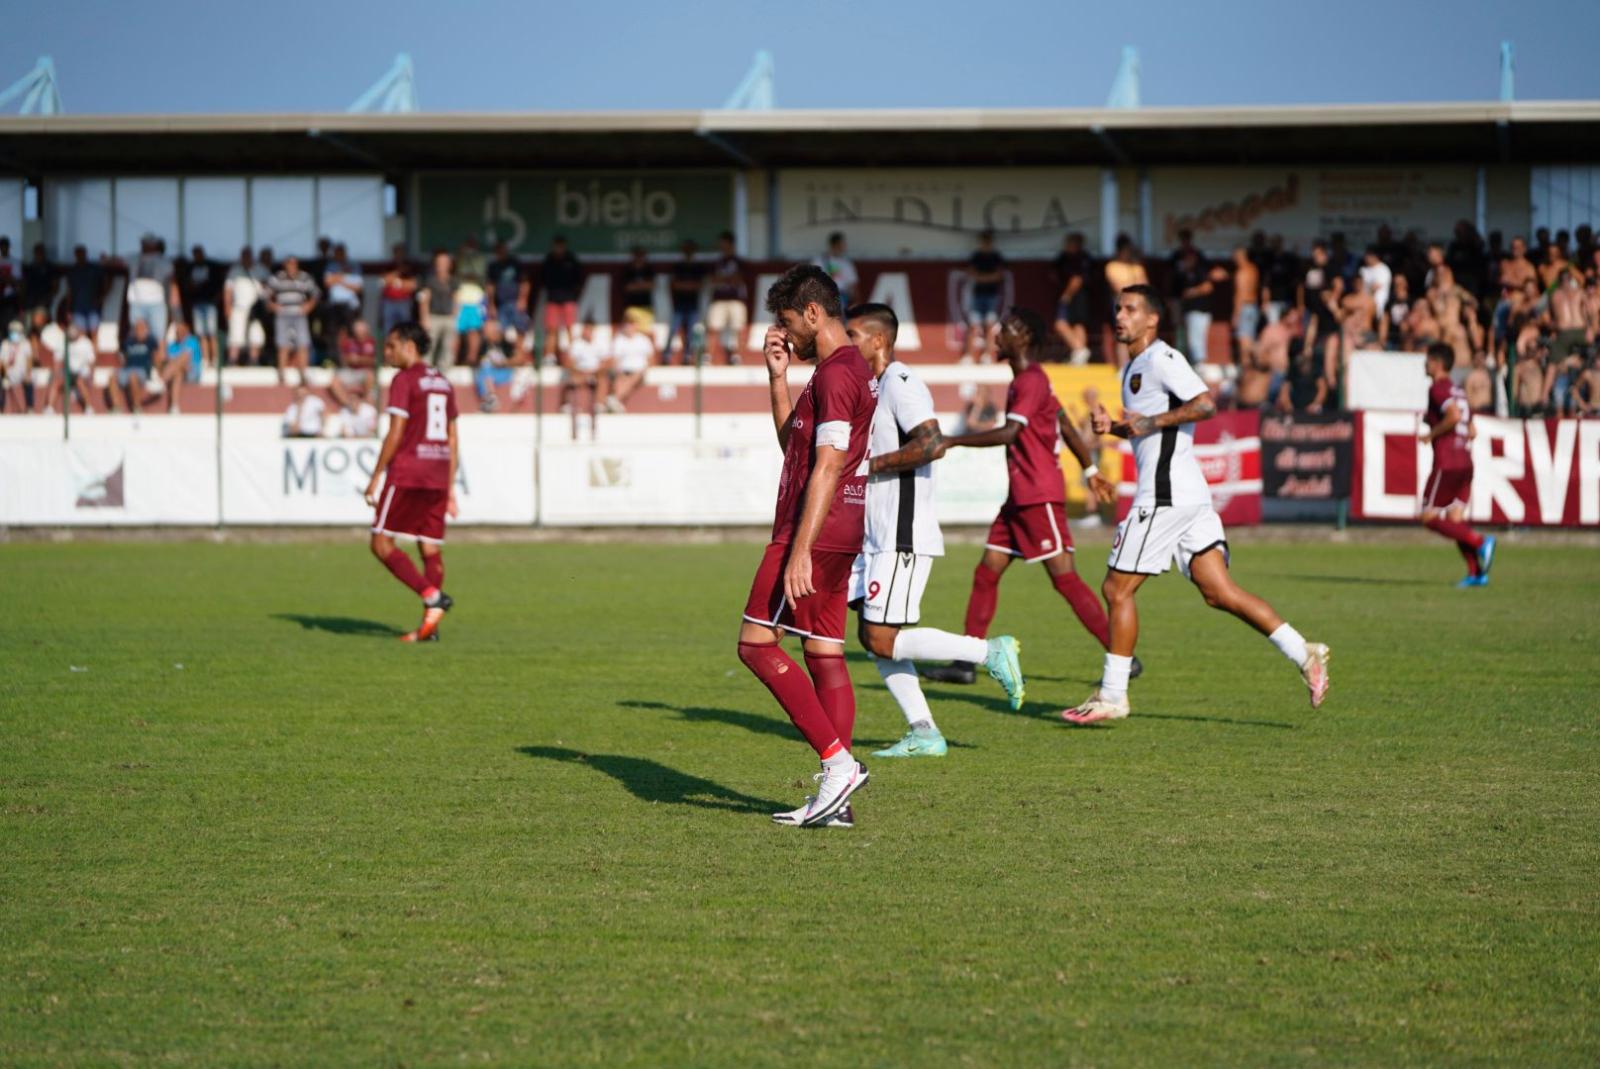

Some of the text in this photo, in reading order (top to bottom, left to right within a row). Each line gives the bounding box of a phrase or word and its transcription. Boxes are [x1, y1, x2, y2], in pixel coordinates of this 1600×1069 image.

[556, 179, 677, 227] bielo
[425, 392, 448, 441] 8
[867, 580, 881, 601] 9
